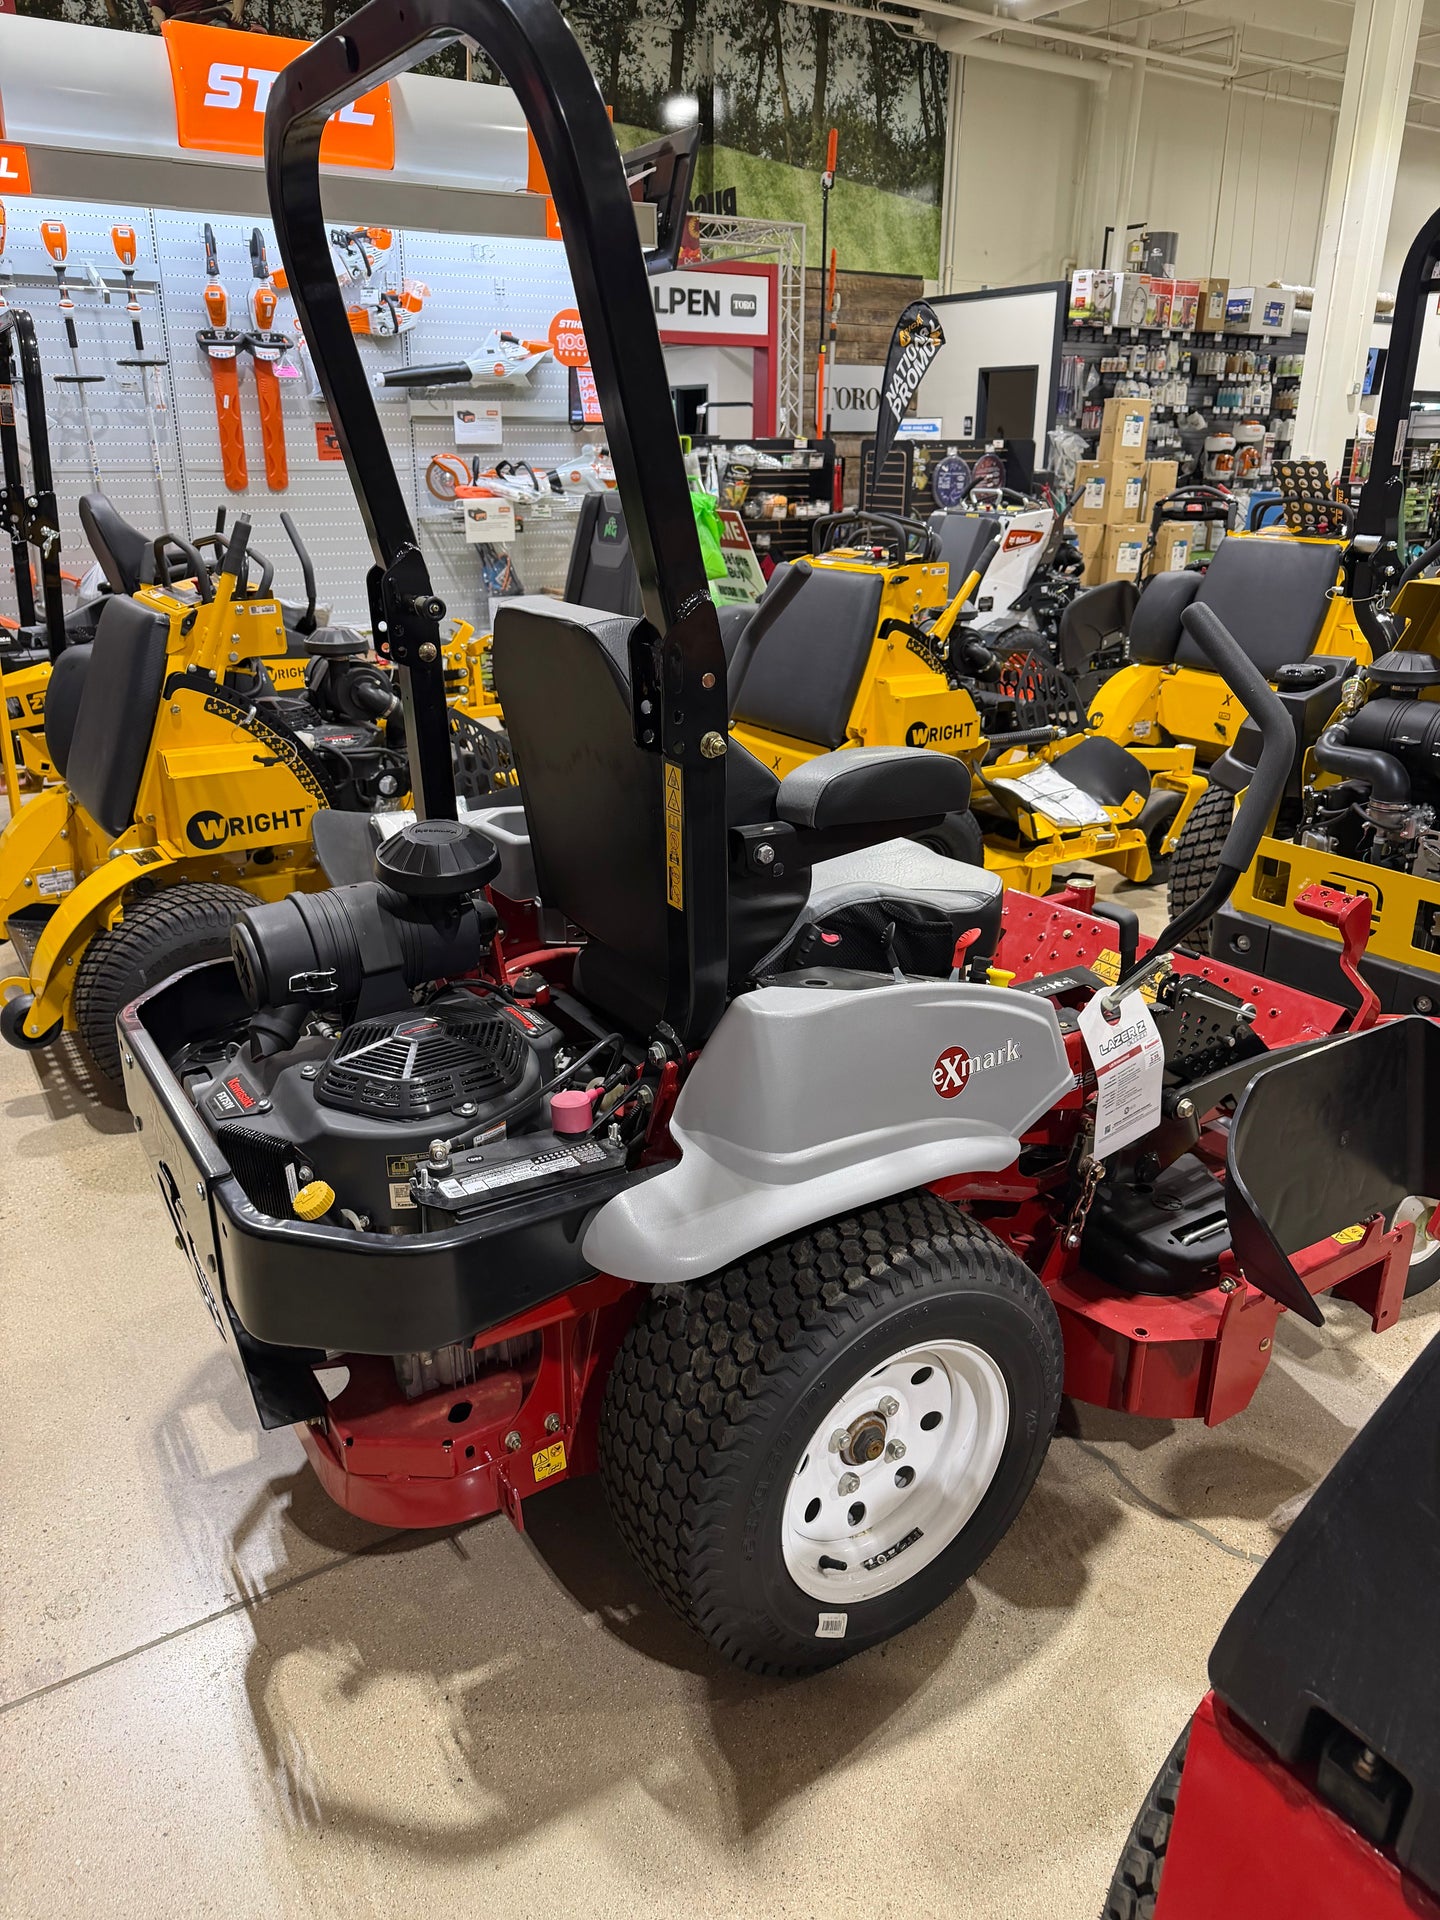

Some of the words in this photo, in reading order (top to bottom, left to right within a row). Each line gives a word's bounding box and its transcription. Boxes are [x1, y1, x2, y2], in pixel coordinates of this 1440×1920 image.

[203, 62, 376, 126] STL
[558, 319, 584, 329] STIH
[556, 333, 587, 351] 100
[891, 337, 937, 424] PROMO
[265, 665, 306, 683] WRIGH
[207, 703, 219, 711] 5.5
[1221, 693, 1234, 707] X
[231, 712, 238, 721] 5
[906, 721, 973, 749] WRIGHT
[291, 761, 298, 770] 3
[771, 755, 782, 771] X
[187, 807, 306, 849] WRIGHT
[1098, 1025, 1138, 1056] LAZER
[1136, 1019, 1147, 1034] Z
[931, 1038, 1022, 1092] eXmark
[227, 1076, 257, 1109] Kawasaki
